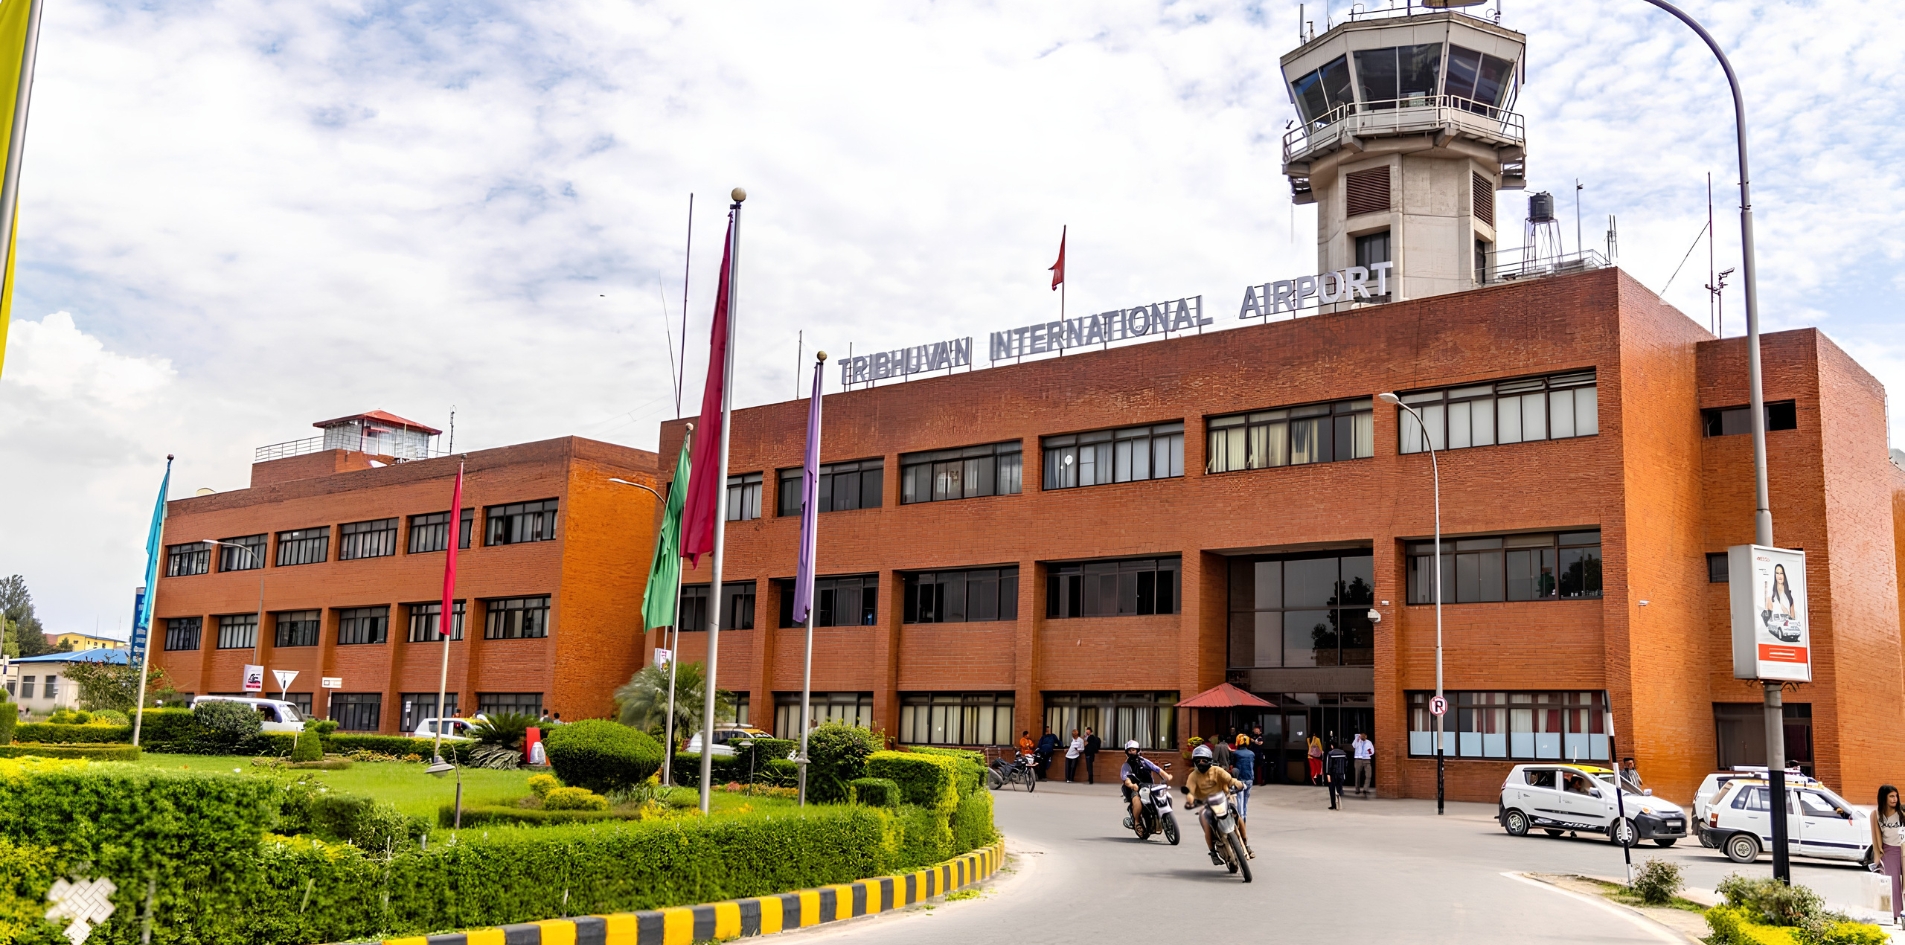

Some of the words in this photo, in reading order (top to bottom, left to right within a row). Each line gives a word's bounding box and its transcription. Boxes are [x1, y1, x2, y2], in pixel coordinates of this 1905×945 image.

[838, 336, 970, 385] TRIBHUVAN
[990, 295, 1213, 361] INTERNATIONAL
[1239, 261, 1393, 319] AIRPORT
[1435, 700, 1443, 712] P
